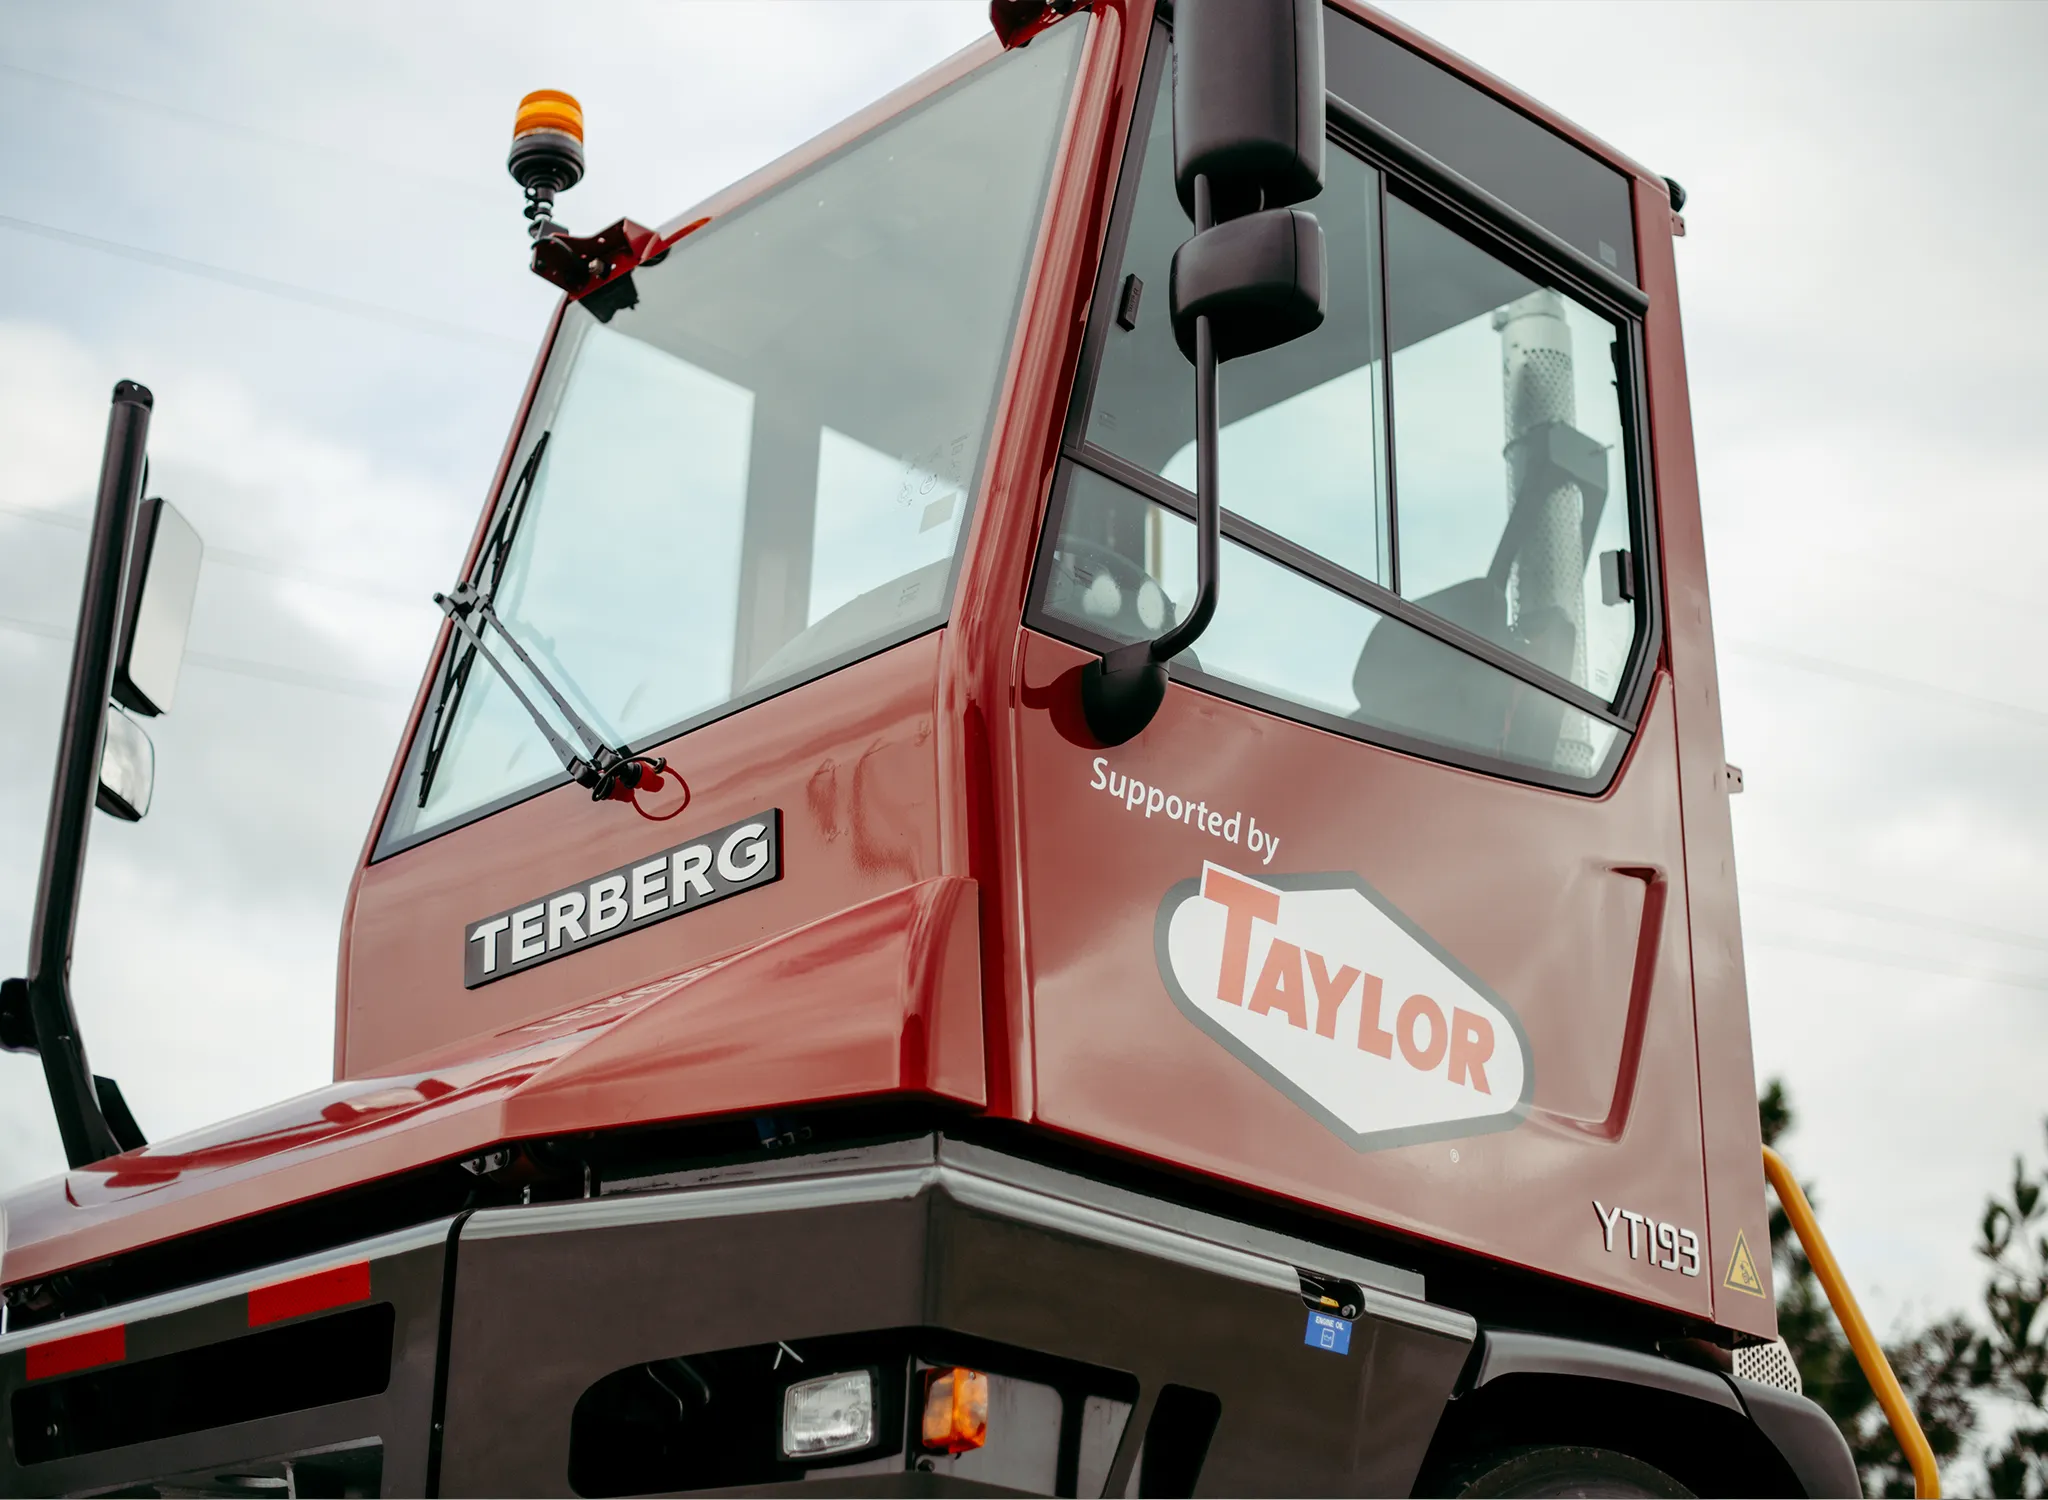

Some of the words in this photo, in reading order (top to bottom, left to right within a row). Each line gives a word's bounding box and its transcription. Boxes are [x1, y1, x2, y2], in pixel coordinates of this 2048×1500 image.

[1090, 757, 1242, 844] Supported
[1247, 817, 1280, 865] by
[469, 823, 770, 974] TERBERG
[1203, 867, 1496, 1096] TAYLOR
[1592, 1200, 1700, 1277] YT193
[1315, 1316, 1335, 1328] ENGINE
[1335, 1321, 1344, 1331] OIL
